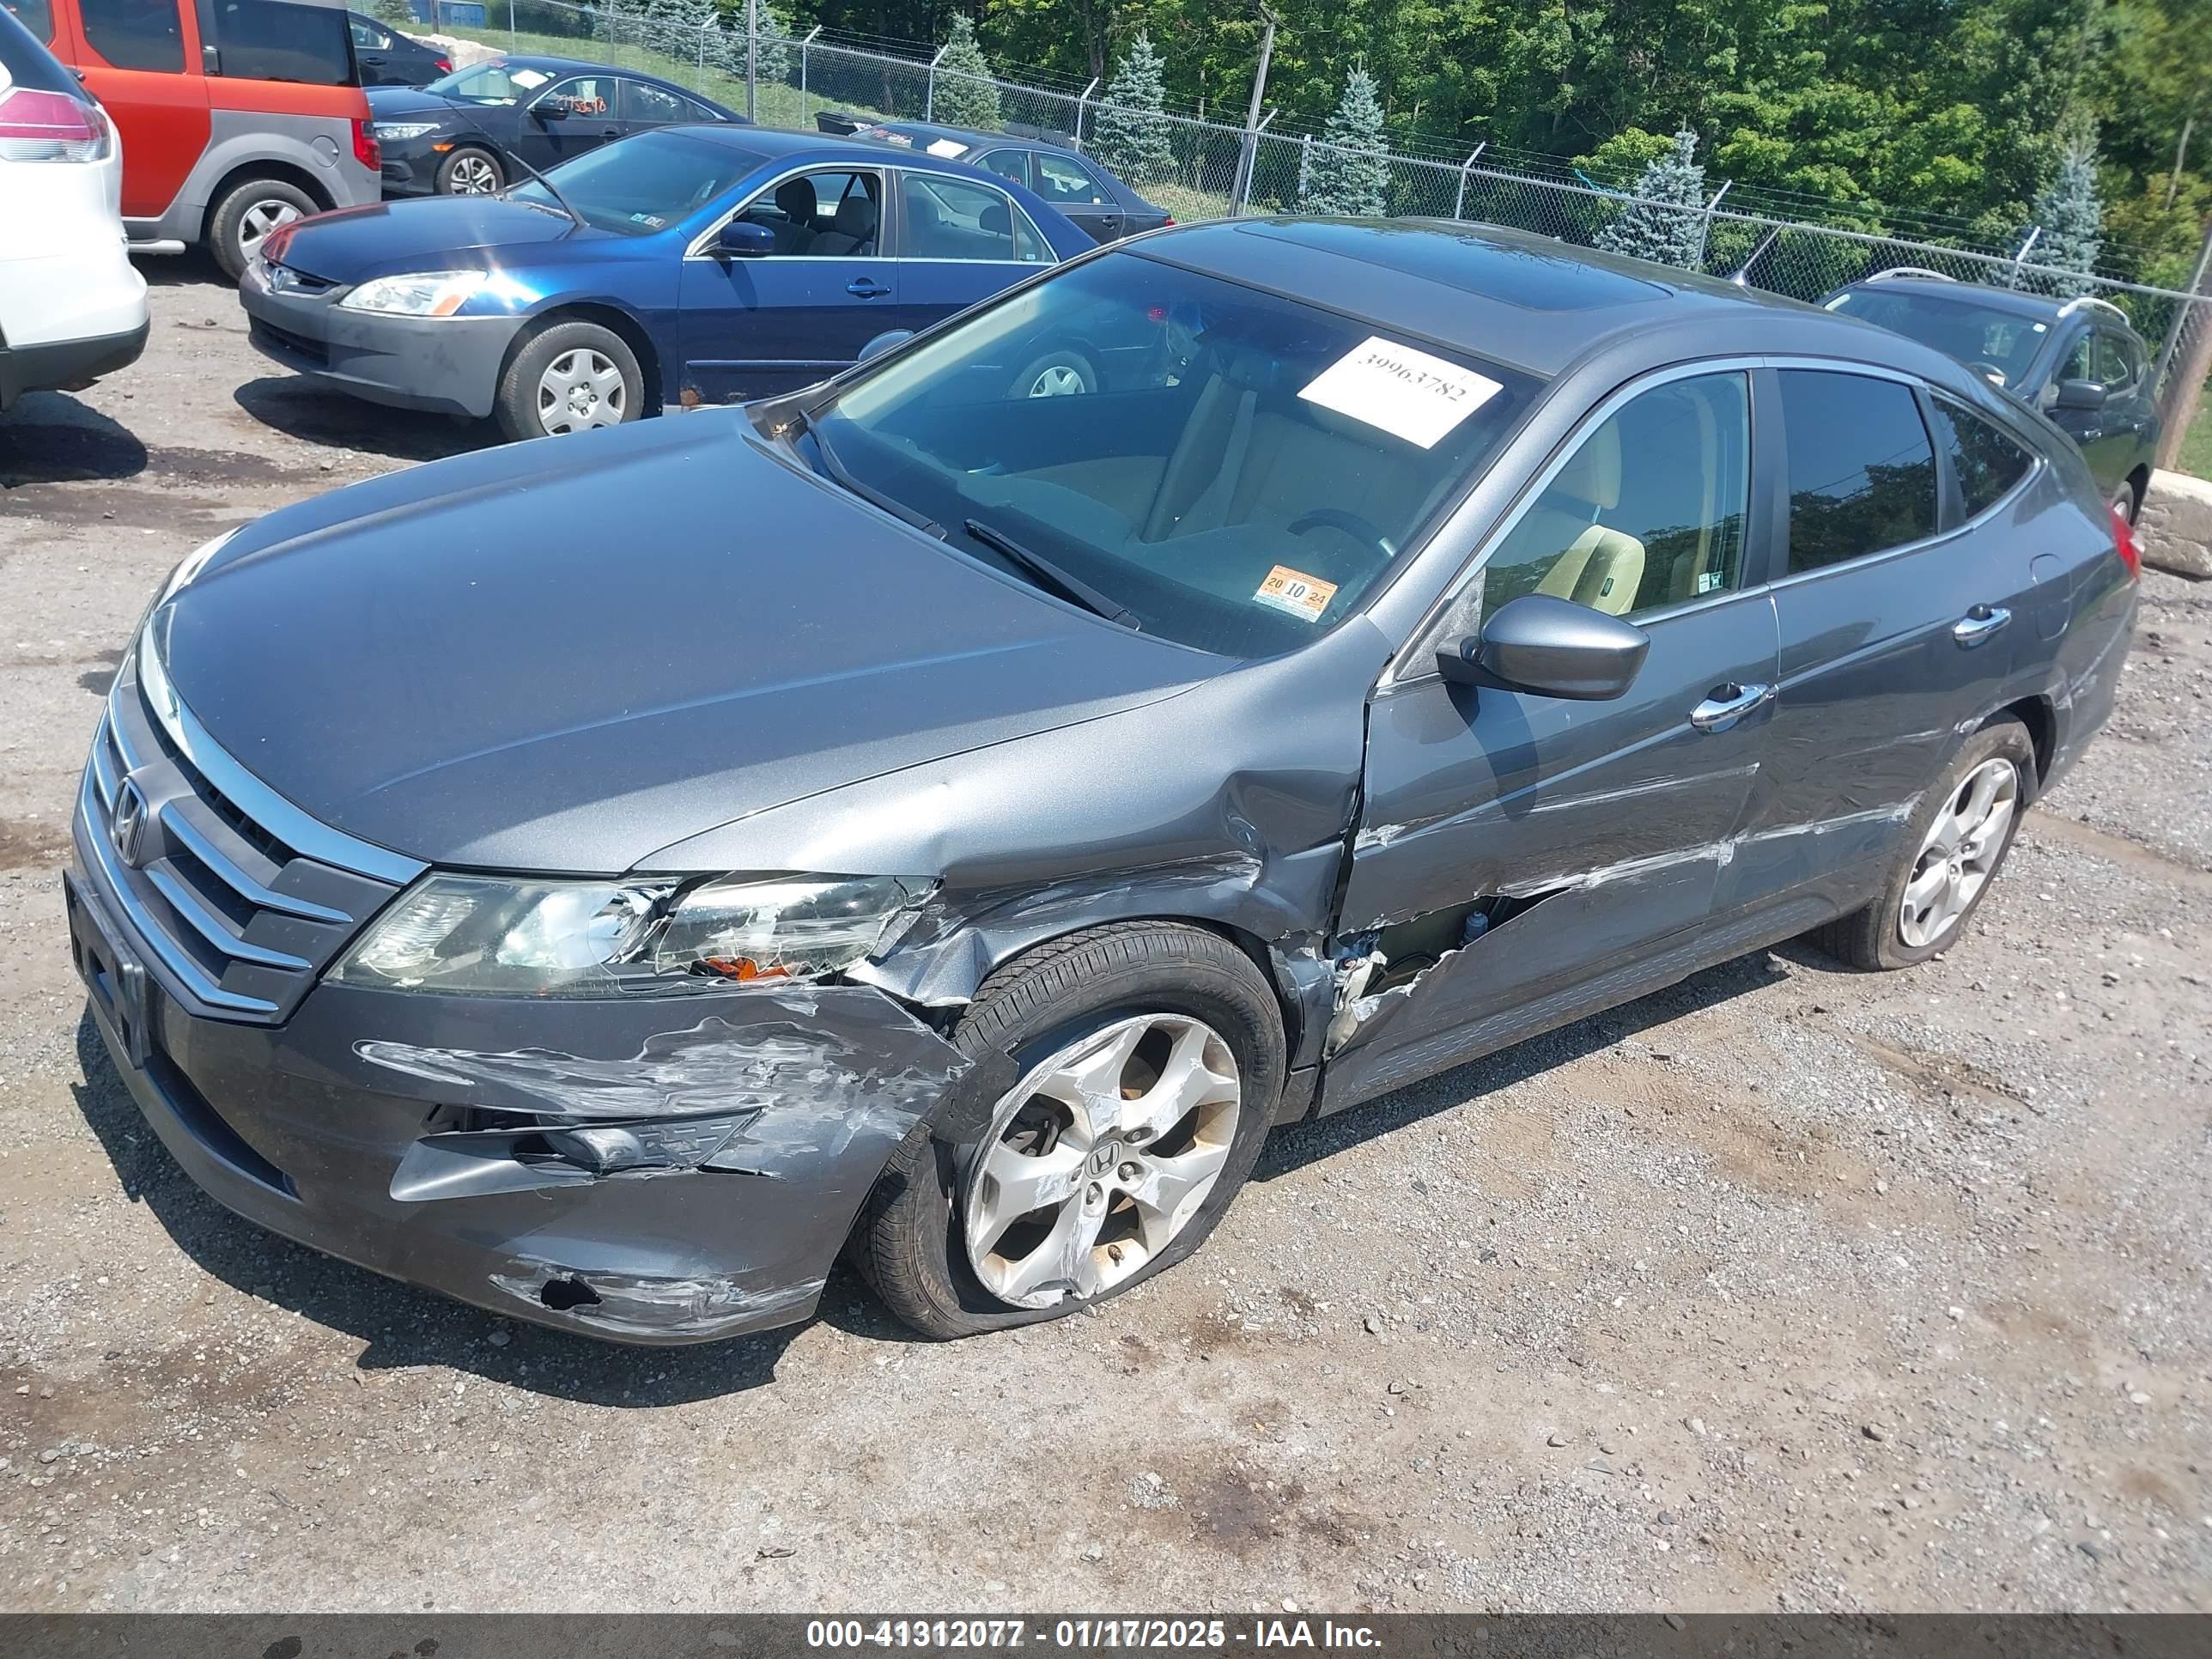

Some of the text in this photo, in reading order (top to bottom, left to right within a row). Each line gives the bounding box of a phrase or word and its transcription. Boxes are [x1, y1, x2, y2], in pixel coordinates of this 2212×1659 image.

[1358, 354, 1467, 402] 39963782
[1267, 577, 1284, 589] 20
[1285, 582, 1306, 599] 10
[1308, 592, 1327, 605] 24
